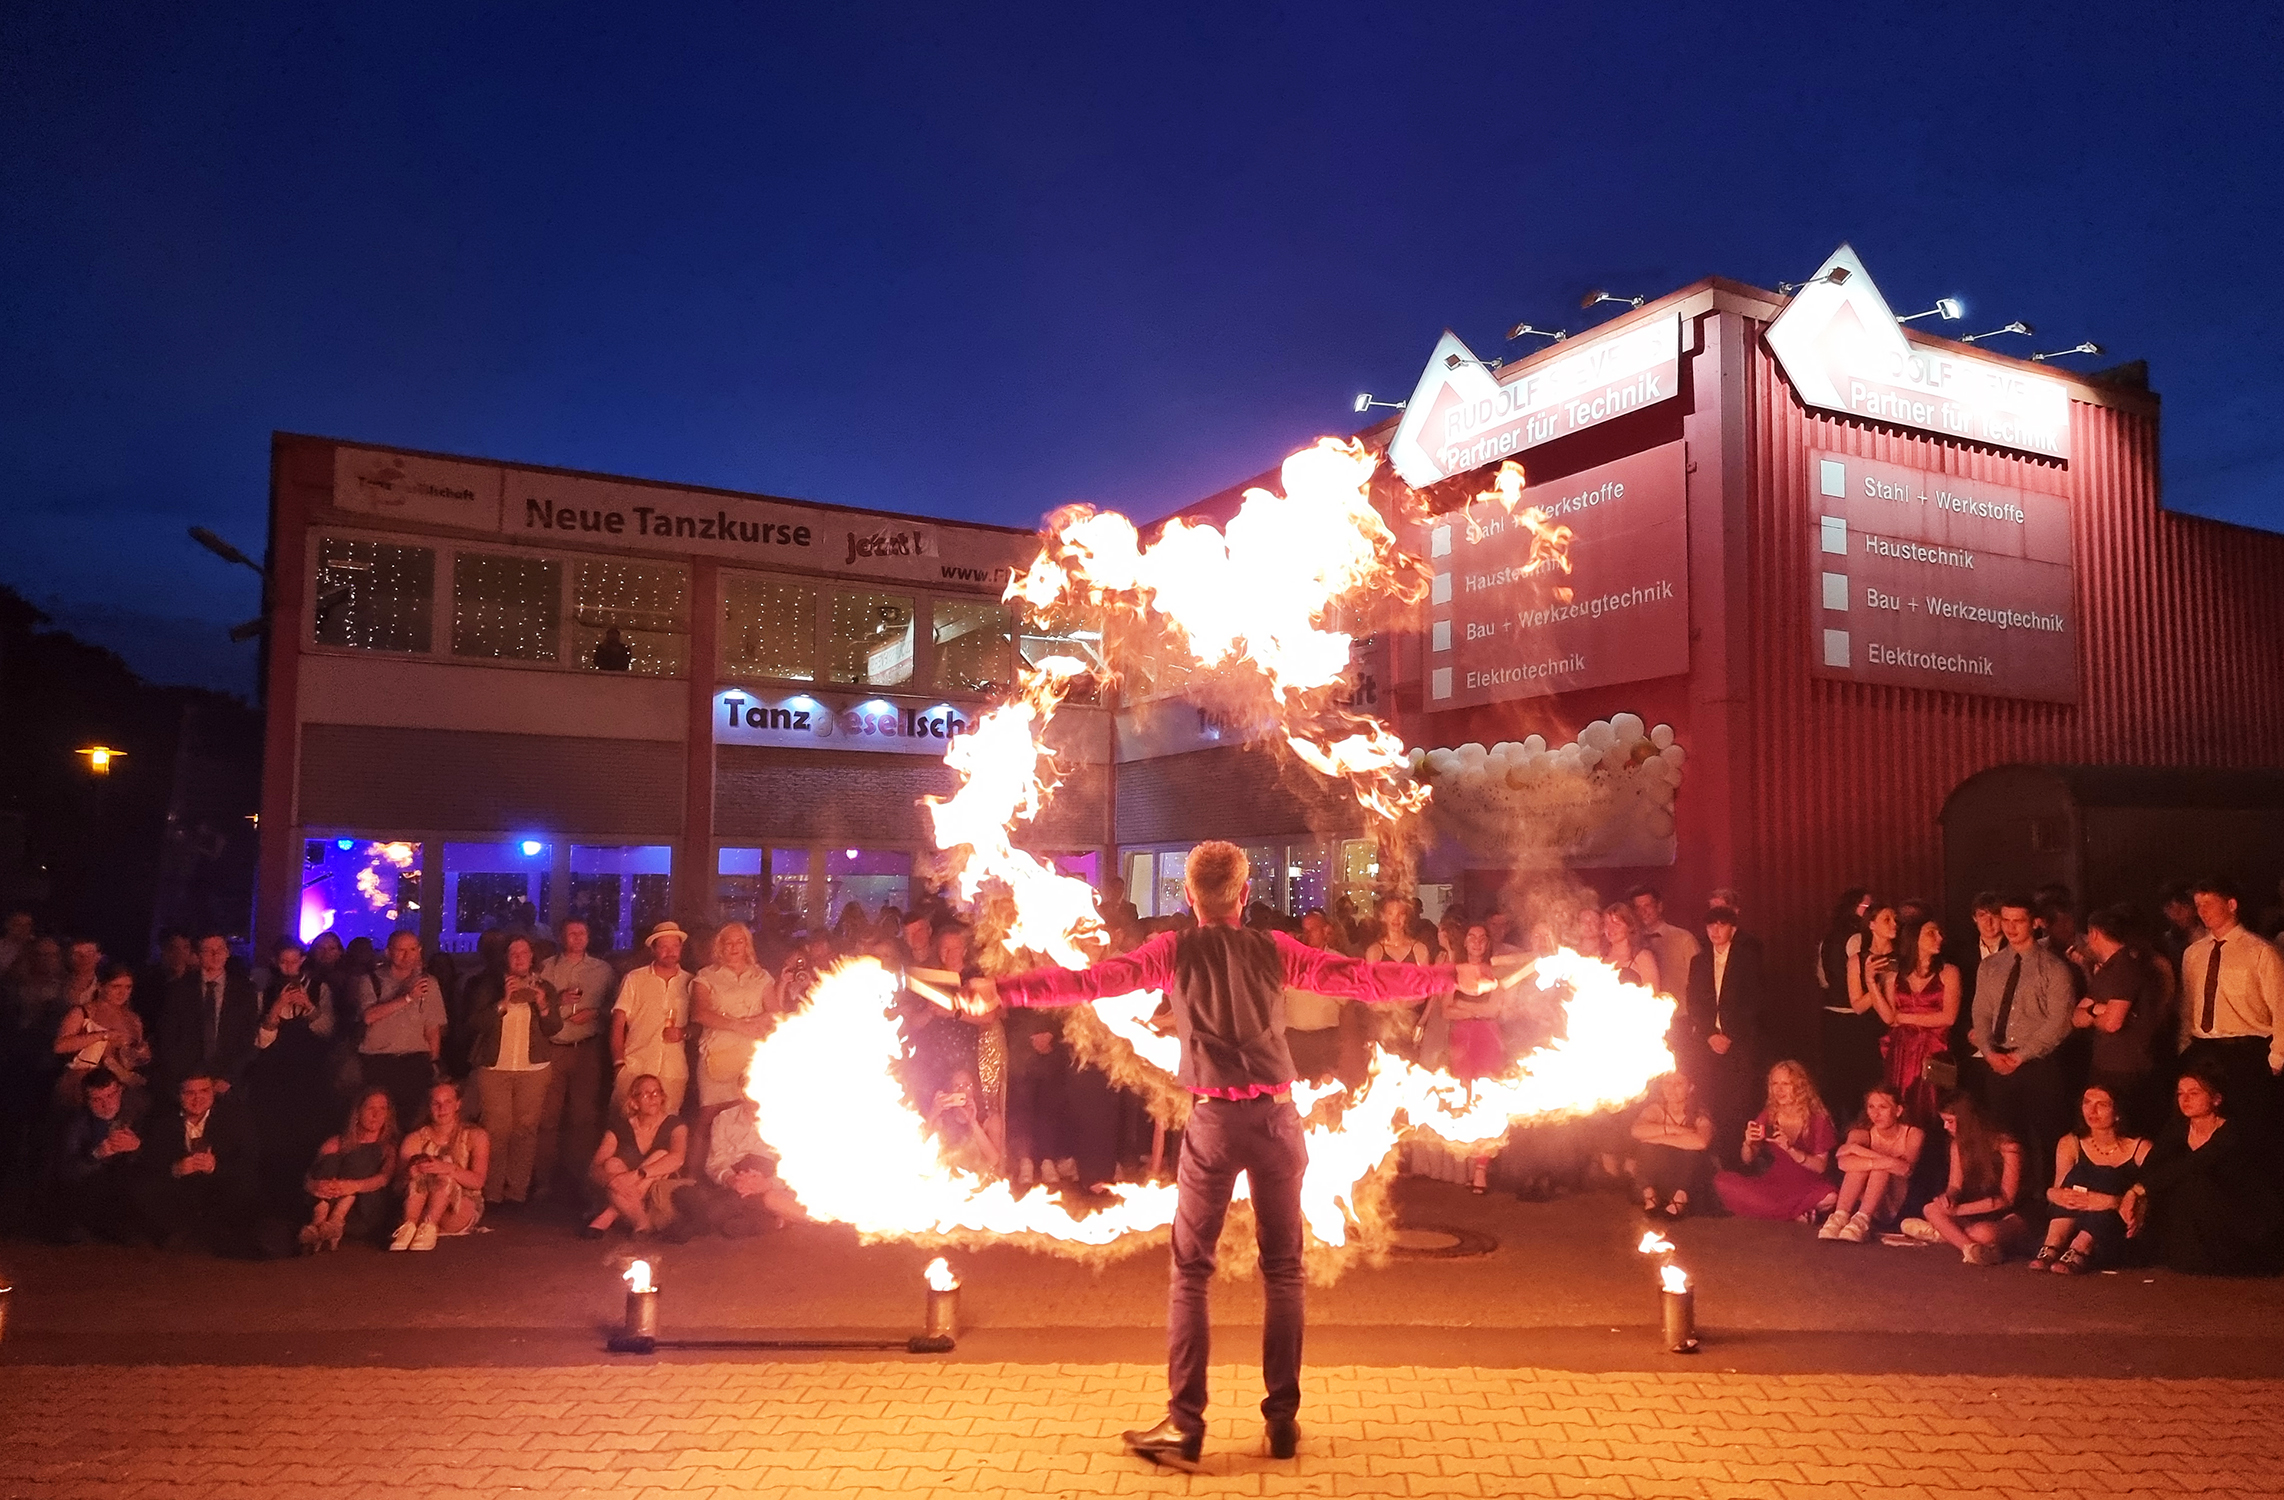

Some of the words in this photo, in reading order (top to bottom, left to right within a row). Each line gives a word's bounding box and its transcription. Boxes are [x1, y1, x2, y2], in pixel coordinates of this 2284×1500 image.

[1446, 425, 1521, 474] Partner
[1526, 412, 1558, 444] für
[1564, 373, 1662, 428] Technik
[1447, 376, 1539, 438] RUDOLF
[1851, 381, 1935, 424] Partner
[1941, 401, 1972, 433] für
[525, 498, 625, 534] Neue
[633, 507, 812, 547] Tanzkurse
[1864, 476, 1910, 503] Stahl
[1936, 490, 2025, 524] Werkstoffe
[1866, 534, 1974, 570] Haustechnik
[1466, 622, 1495, 641] Bau
[1518, 580, 1674, 629] Werkzeugtechnik
[1867, 588, 1900, 610] Bau
[1926, 596, 2064, 632] Werkzeugtechnik
[1466, 653, 1586, 689] Elektrotechnik
[1868, 643, 1994, 676] Elektrotechnik
[724, 698, 968, 739] Tanzgesellsch
